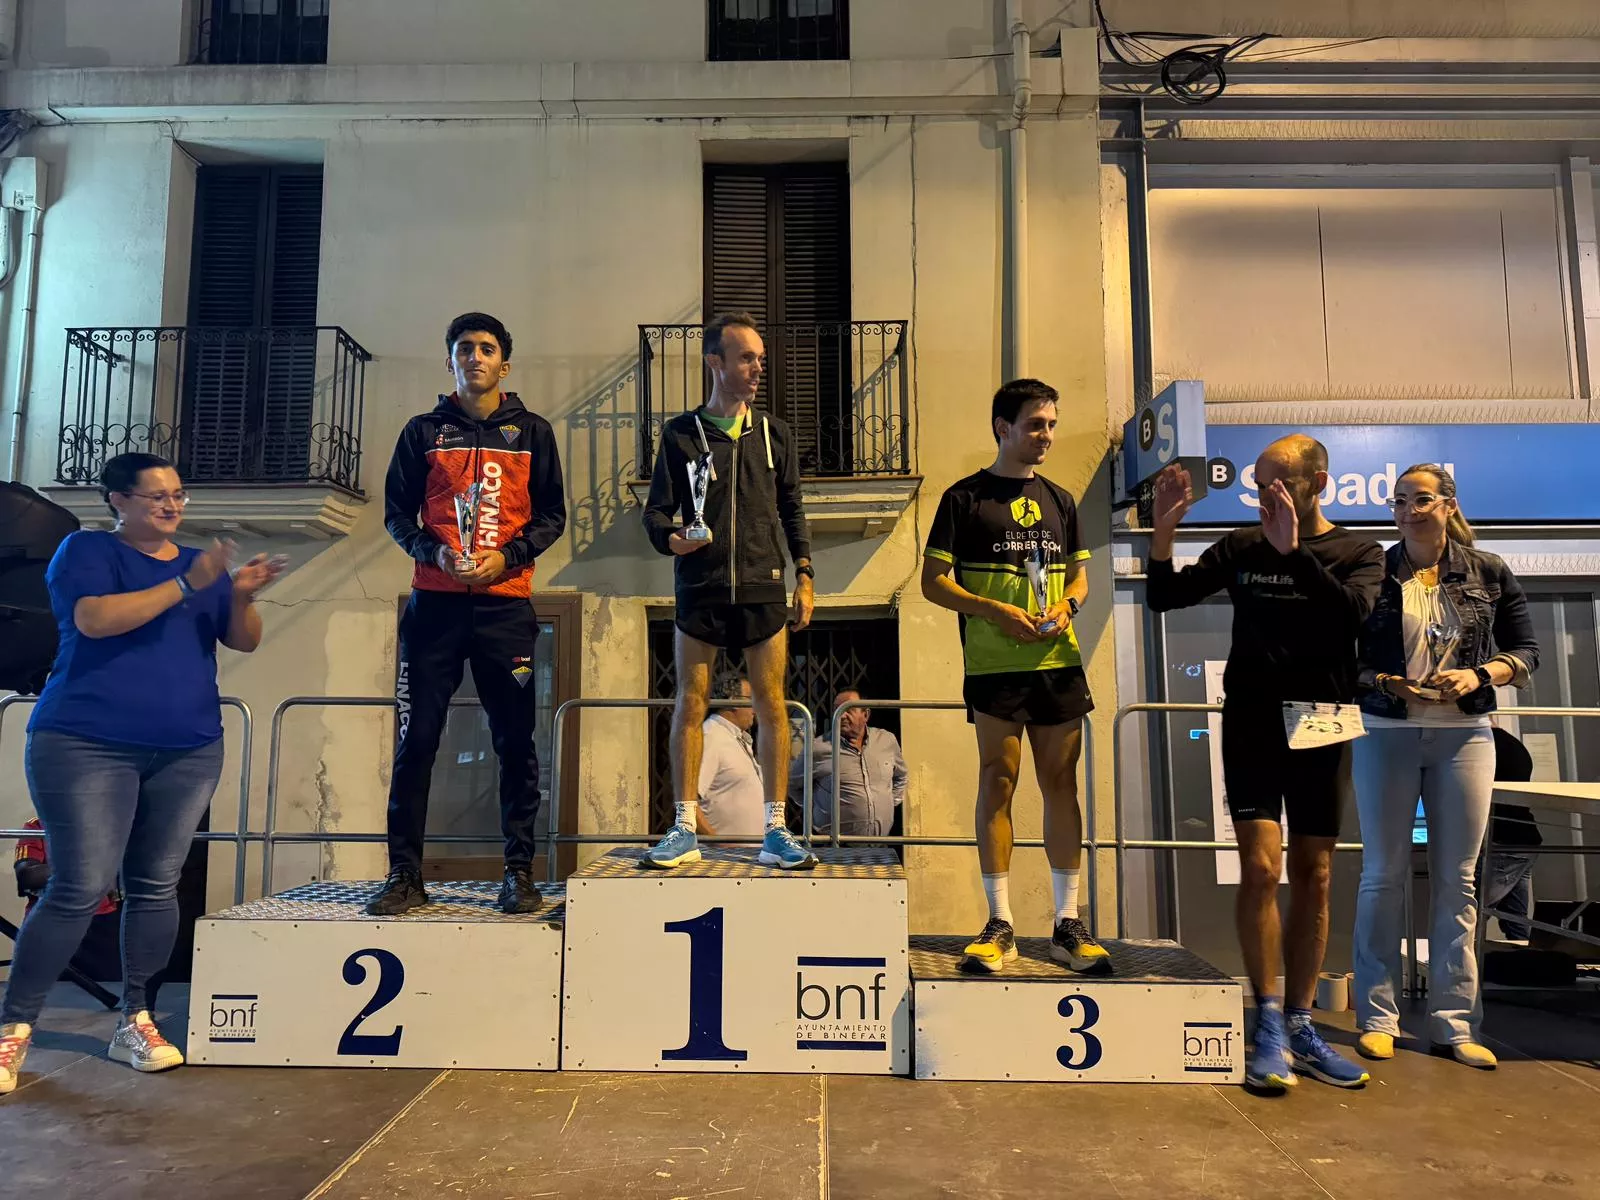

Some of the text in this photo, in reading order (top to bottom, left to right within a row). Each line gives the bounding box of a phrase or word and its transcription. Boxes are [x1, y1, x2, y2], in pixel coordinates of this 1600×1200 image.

[1143, 402, 1175, 463] B S
[1212, 464, 1228, 483] B
[479, 461, 503, 548] HINACO
[1005, 530, 1052, 540] EL RETO DE
[1251, 573, 1294, 585] MetLife
[661, 906, 748, 1061] 1
[796, 971, 886, 1021] bnf
[209, 1001, 258, 1028] bnf
[337, 947, 405, 1057] 2
[796, 1023, 887, 1032] AYUNTAMIENTO
[796, 1031, 887, 1040] DE BINÉFAR
[1056, 994, 1103, 1071] 3
[1183, 1029, 1233, 1057] bnf
